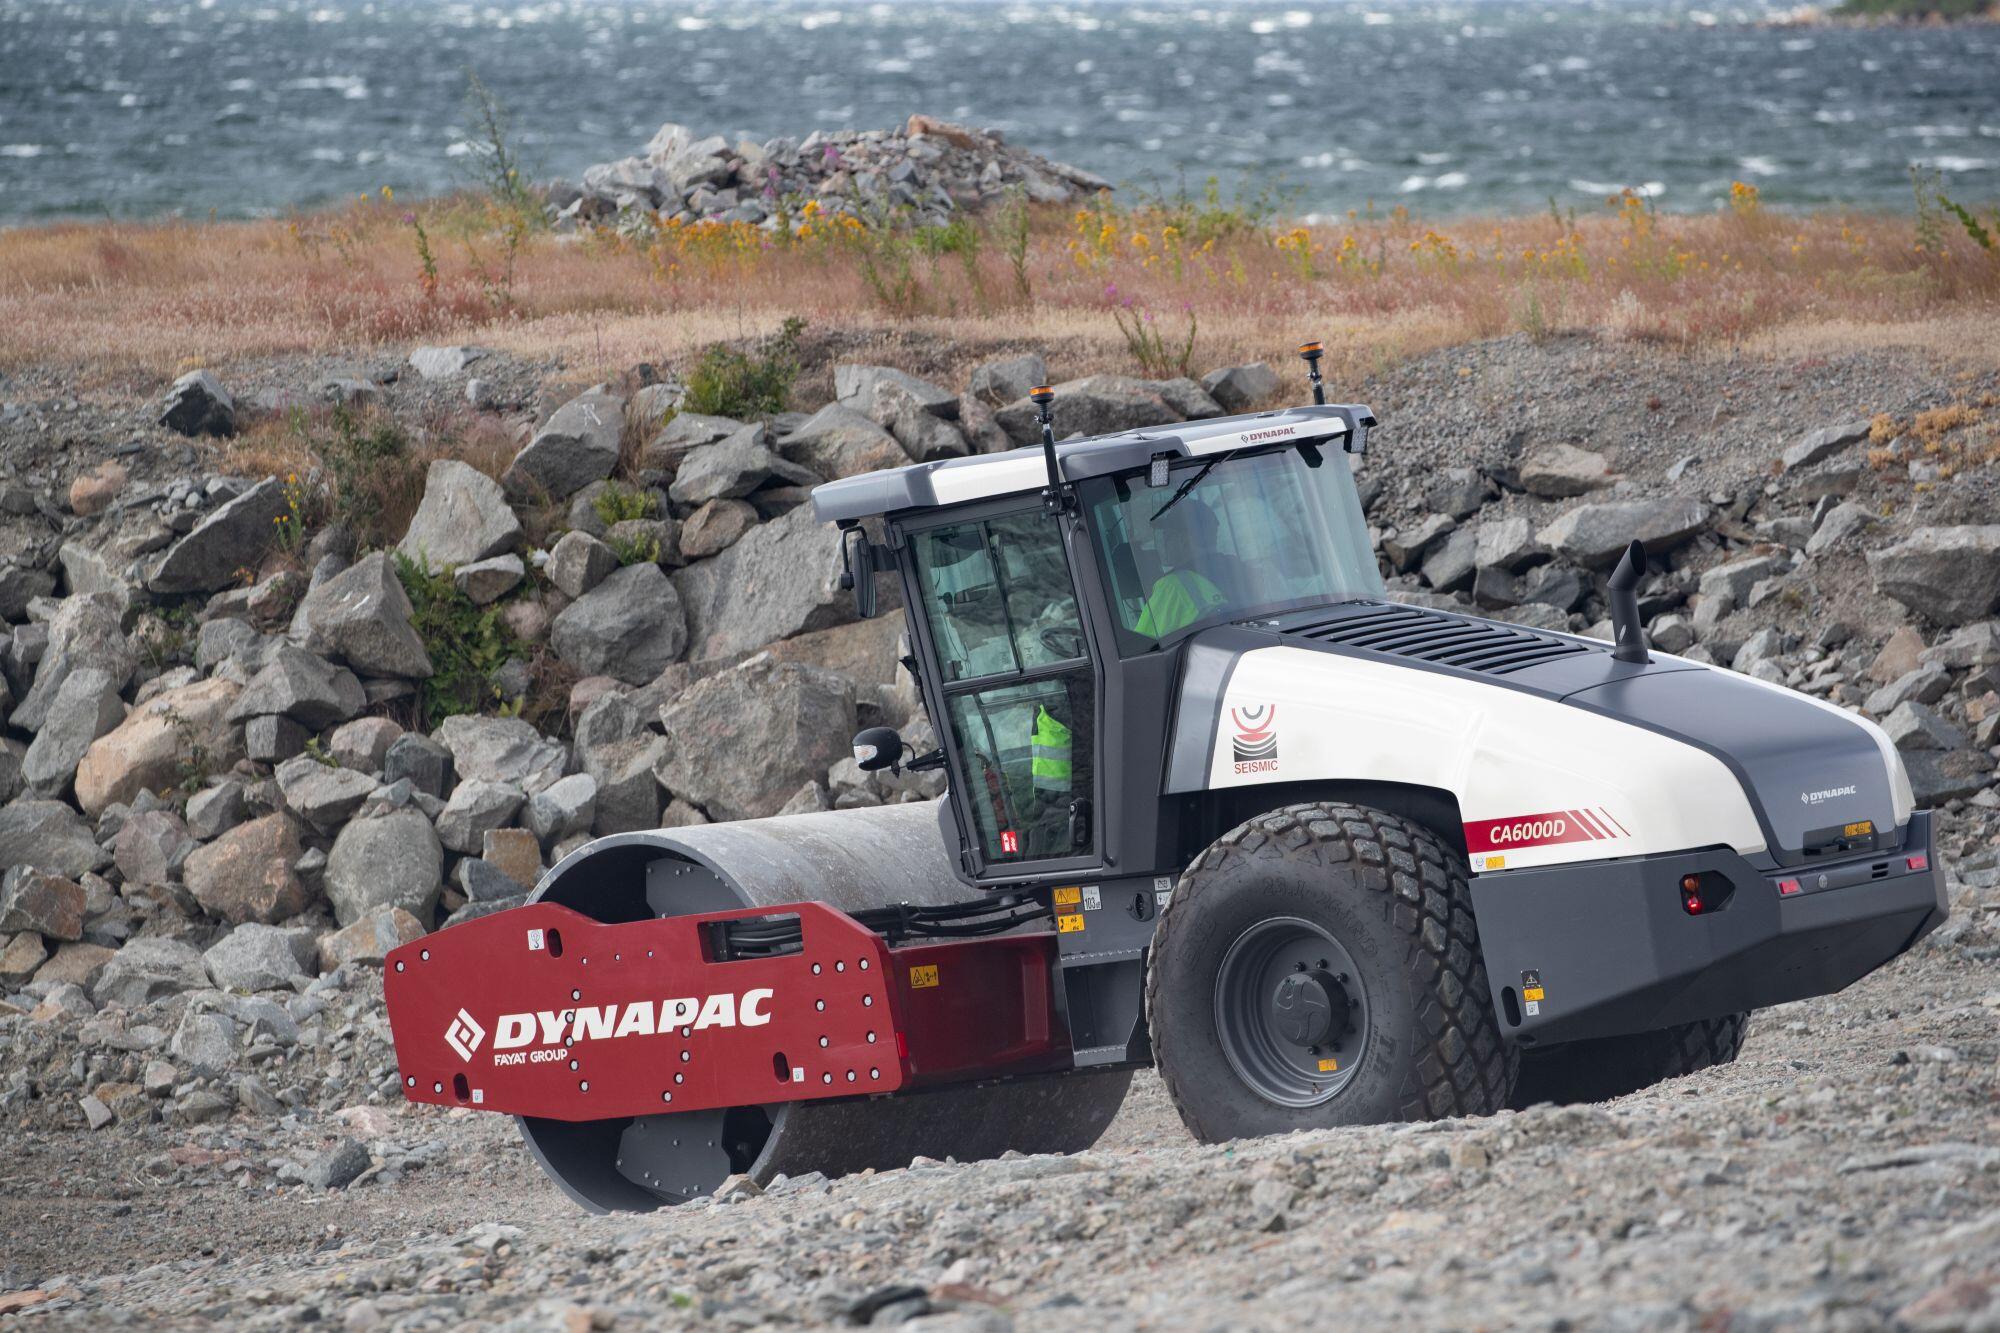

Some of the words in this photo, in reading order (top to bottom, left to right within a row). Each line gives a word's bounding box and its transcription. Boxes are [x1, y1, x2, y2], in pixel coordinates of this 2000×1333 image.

[1249, 427, 1297, 441] DYNAPAC
[1234, 759, 1278, 774] SEISMIC
[1809, 785, 1857, 801] DYNAPAC
[1490, 819, 1566, 844] CA6000D
[493, 988, 774, 1049] DYNAPAC
[494, 1053, 527, 1066] FAYAT
[530, 1049, 568, 1063] GROUP
